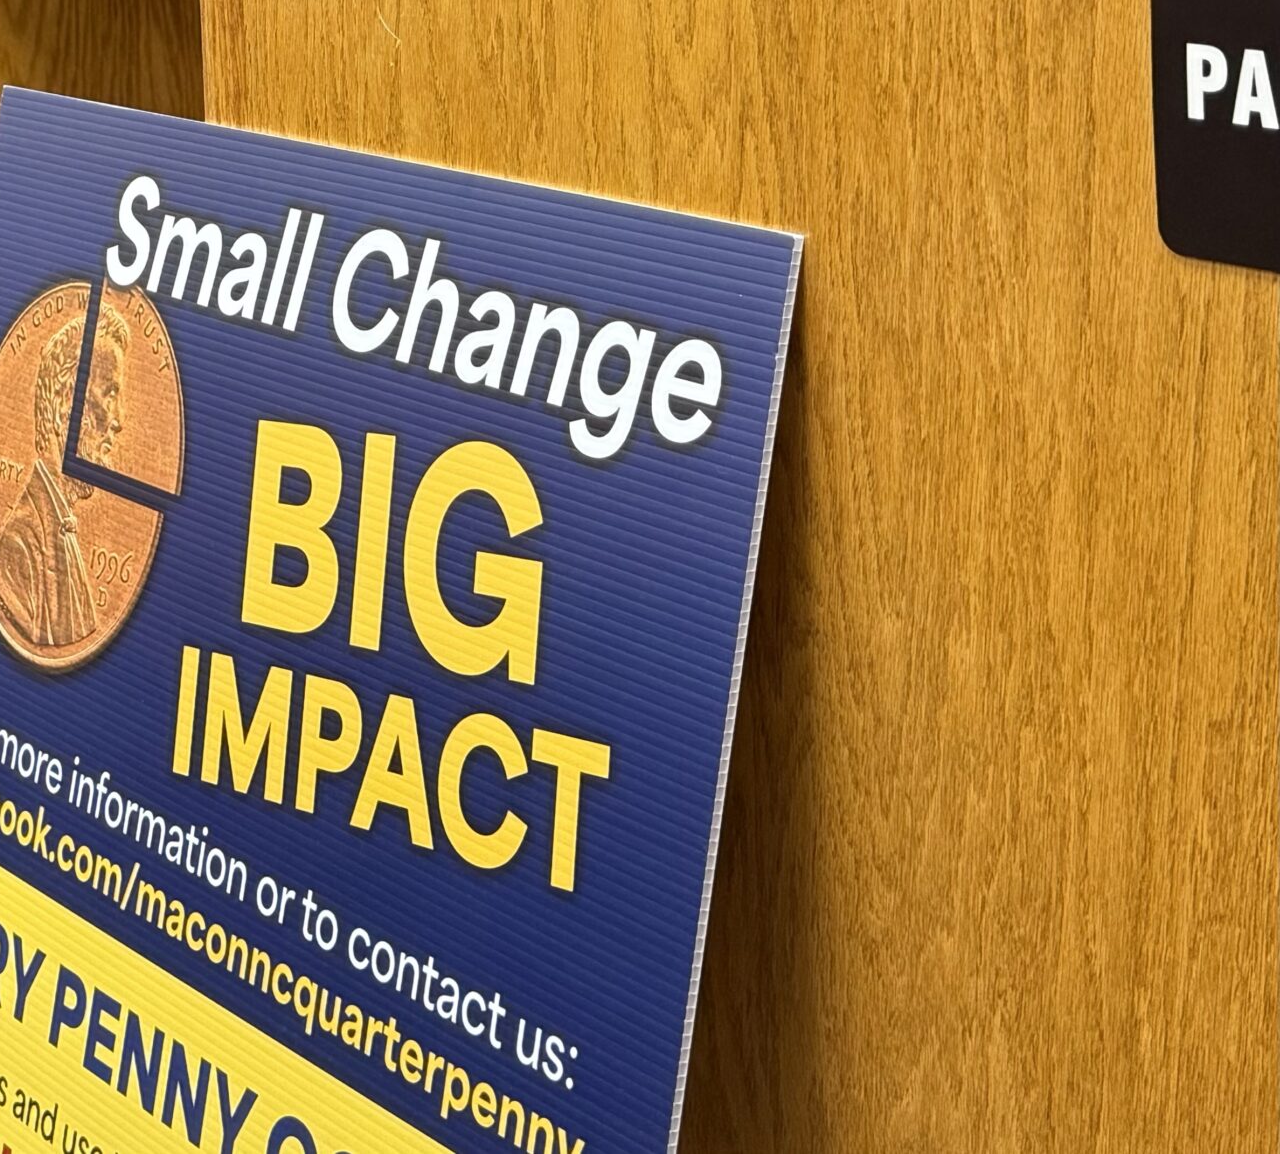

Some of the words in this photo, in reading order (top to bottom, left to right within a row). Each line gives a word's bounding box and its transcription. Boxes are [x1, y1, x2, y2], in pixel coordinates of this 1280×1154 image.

[10, 331, 28, 357] IN
[32, 295, 64, 327] GOD
[106, 176, 324, 332] Small
[332, 229, 722, 459] Change
[90, 546, 133, 586] 1996
[97, 586, 108, 609] D
[241, 420, 544, 685] BIG
[172, 645, 611, 892] IMPACT
[68, 756, 248, 901] information
[256, 876, 297, 924] or
[302, 891, 339, 951] to
[348, 927, 507, 1050] contact
[516, 1018, 579, 1091] us:
[12, 1089, 59, 1144] and
[62, 1124, 103, 1154] us
[48, 964, 259, 1154] PENNY
